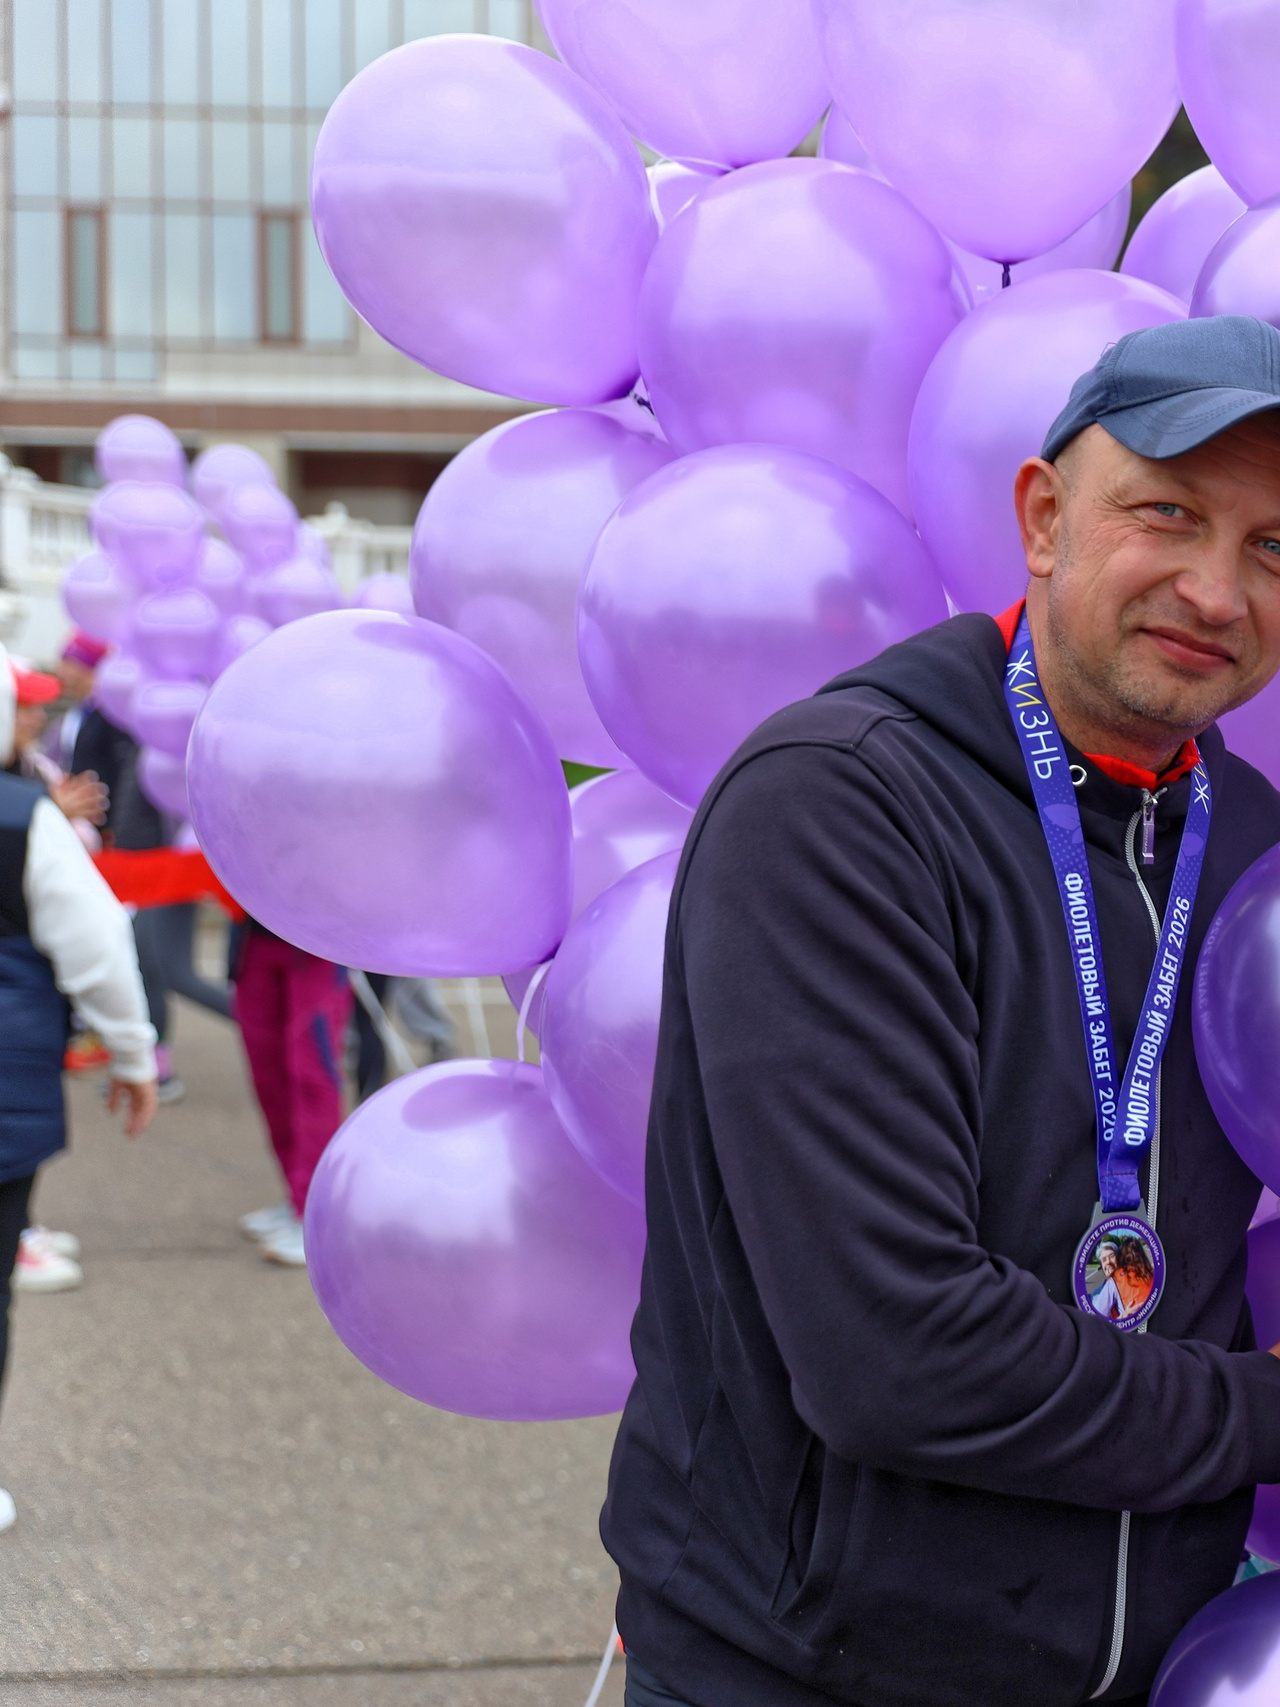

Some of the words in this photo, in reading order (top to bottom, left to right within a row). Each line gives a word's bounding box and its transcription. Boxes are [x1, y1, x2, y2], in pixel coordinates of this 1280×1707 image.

[1006, 649, 1061, 780] ЖИЗНЬ
[1064, 872, 1107, 1017] ФИОЛЕТОВЫЙ
[1089, 1020, 1112, 1082] ЗАБЕГ
[1123, 1009, 1168, 1146] ФИОЛЕТОВЫЙ
[1153, 948, 1179, 1010] ЗАБЕГ
[1168, 896, 1190, 950] 2026
[1098, 1088, 1117, 1142] 2026
[1099, 1218, 1129, 1233] ПРОТИВ
